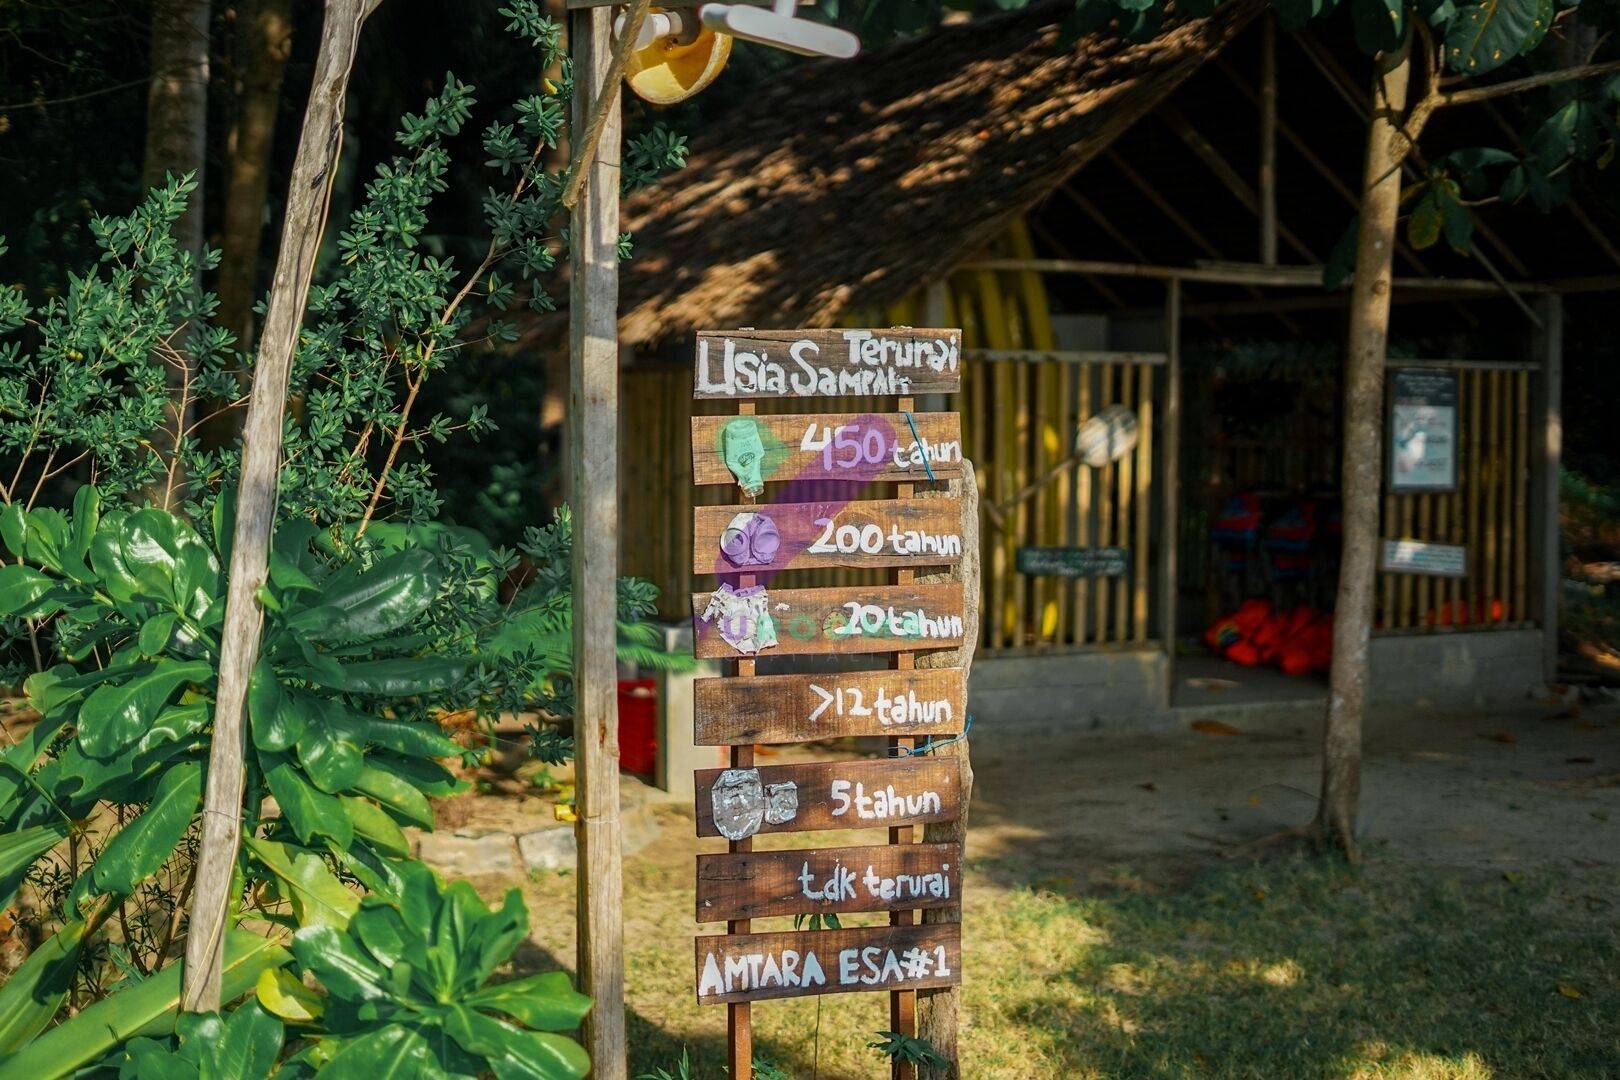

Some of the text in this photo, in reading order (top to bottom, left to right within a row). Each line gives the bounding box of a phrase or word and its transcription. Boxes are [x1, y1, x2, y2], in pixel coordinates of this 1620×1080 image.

[698, 338, 788, 395] Usia
[800, 423, 886, 471] 450
[888, 438, 961, 468] tahun
[807, 517, 961, 556] 200 tahun
[834, 601, 963, 639] 20 tahun
[874, 687, 953, 726] tahun
[831, 780, 941, 819] 5 tahun
[797, 860, 950, 902] tdk terurai
[698, 949, 826, 996] AMTARA
